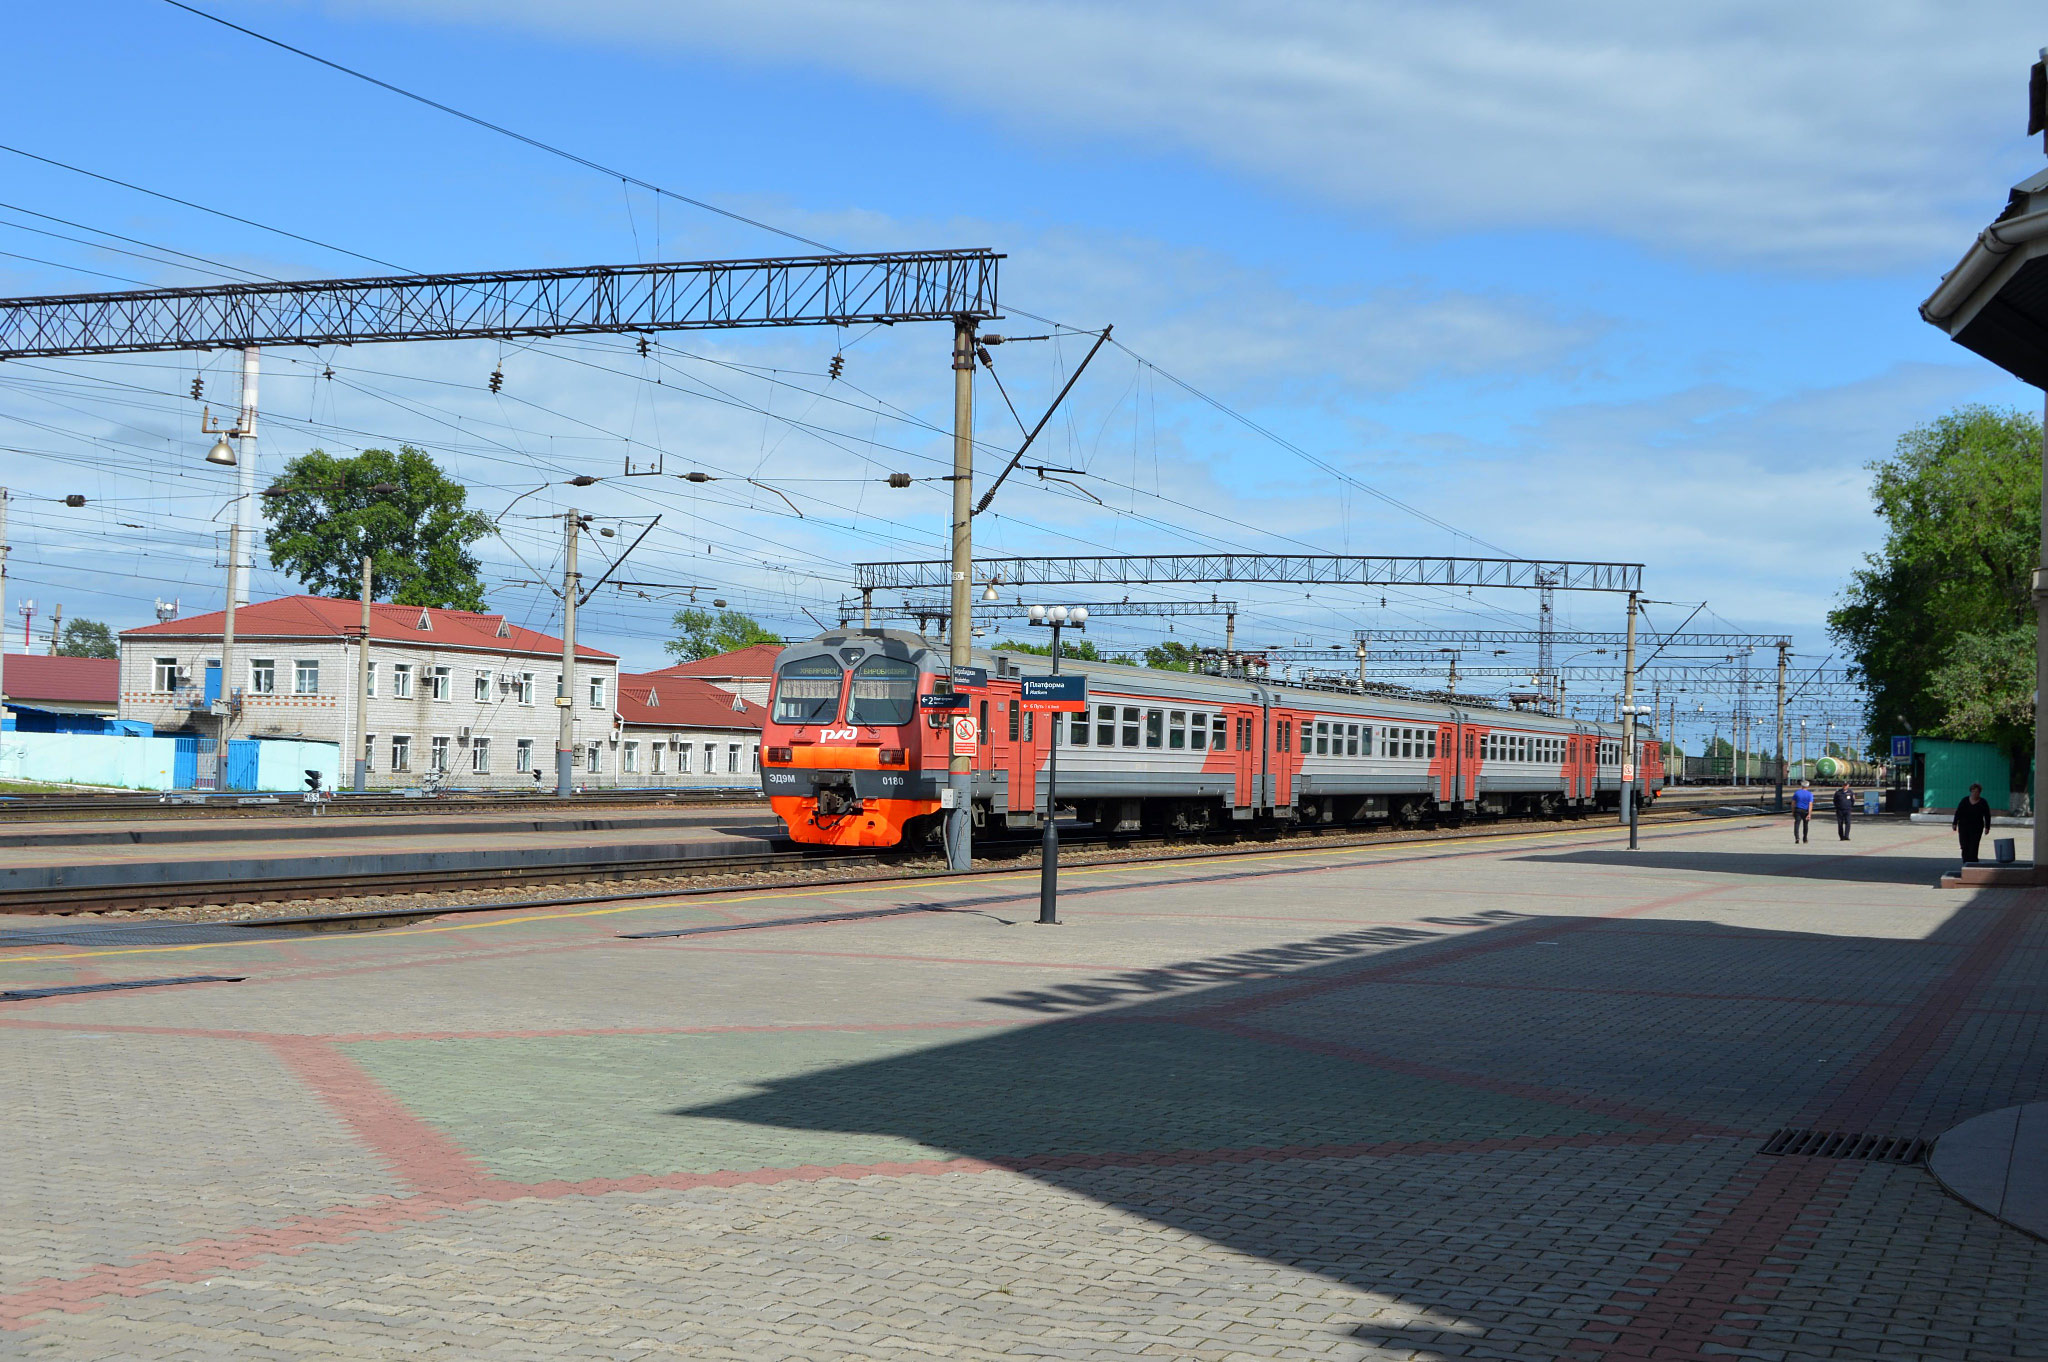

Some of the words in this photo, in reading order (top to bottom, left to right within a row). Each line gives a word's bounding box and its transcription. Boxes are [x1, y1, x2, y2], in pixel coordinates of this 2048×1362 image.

[1024, 682, 1029, 695] 1
[1030, 682, 1065, 690] Платформа
[928, 697, 934, 705] 2
[769, 774, 796, 783] ЭД9М
[882, 777, 904, 786] 0180
